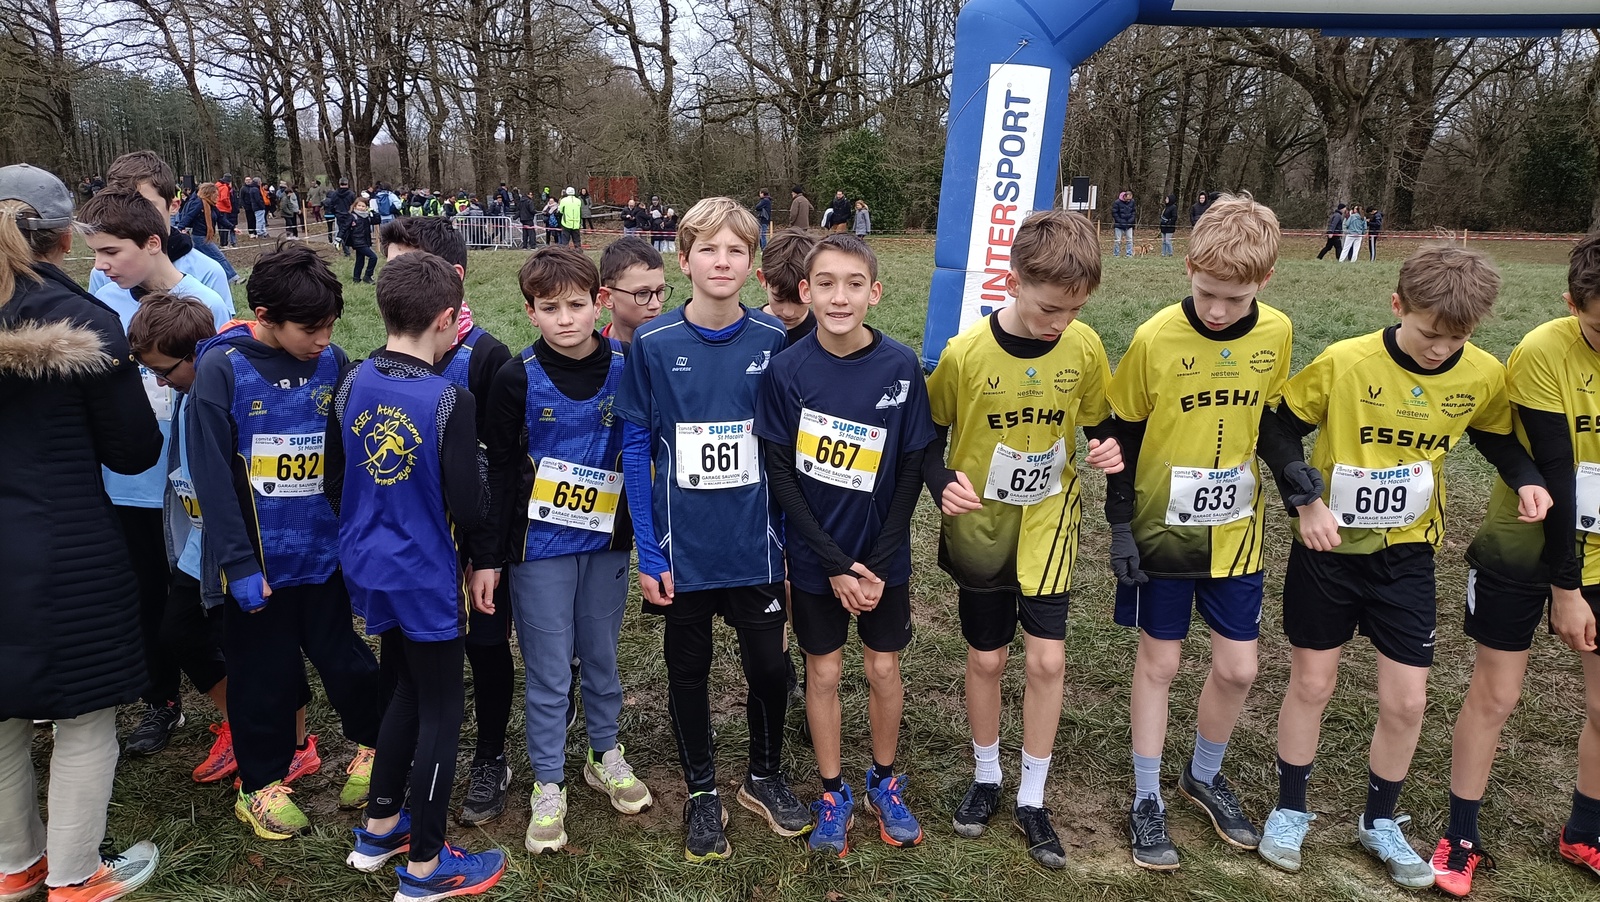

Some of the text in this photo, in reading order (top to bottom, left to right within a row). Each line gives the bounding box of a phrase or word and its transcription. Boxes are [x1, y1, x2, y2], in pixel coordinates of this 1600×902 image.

[980, 89, 1030, 301] INTERSPORT
[1180, 390, 1259, 412] ESSHA
[351, 404, 422, 444] ASEC Athlétisme
[708, 424, 744, 434] SUPER
[832, 420, 868, 436] SUPER
[987, 407, 1065, 430] ESSHA
[290, 436, 323, 446] SUPER
[1360, 426, 1450, 451] ESSHA
[702, 442, 739, 472] 661
[816, 436, 861, 471] 667
[1026, 449, 1054, 462] SUPER
[277, 452, 320, 481] 632
[572, 467, 606, 481] SUPER
[1010, 465, 1052, 492] 625
[1208, 467, 1239, 480] SUPER
[1371, 468, 1410, 480] SUPER
[553, 481, 598, 514] 659
[1194, 484, 1236, 512] 633
[1356, 486, 1407, 513] 609
